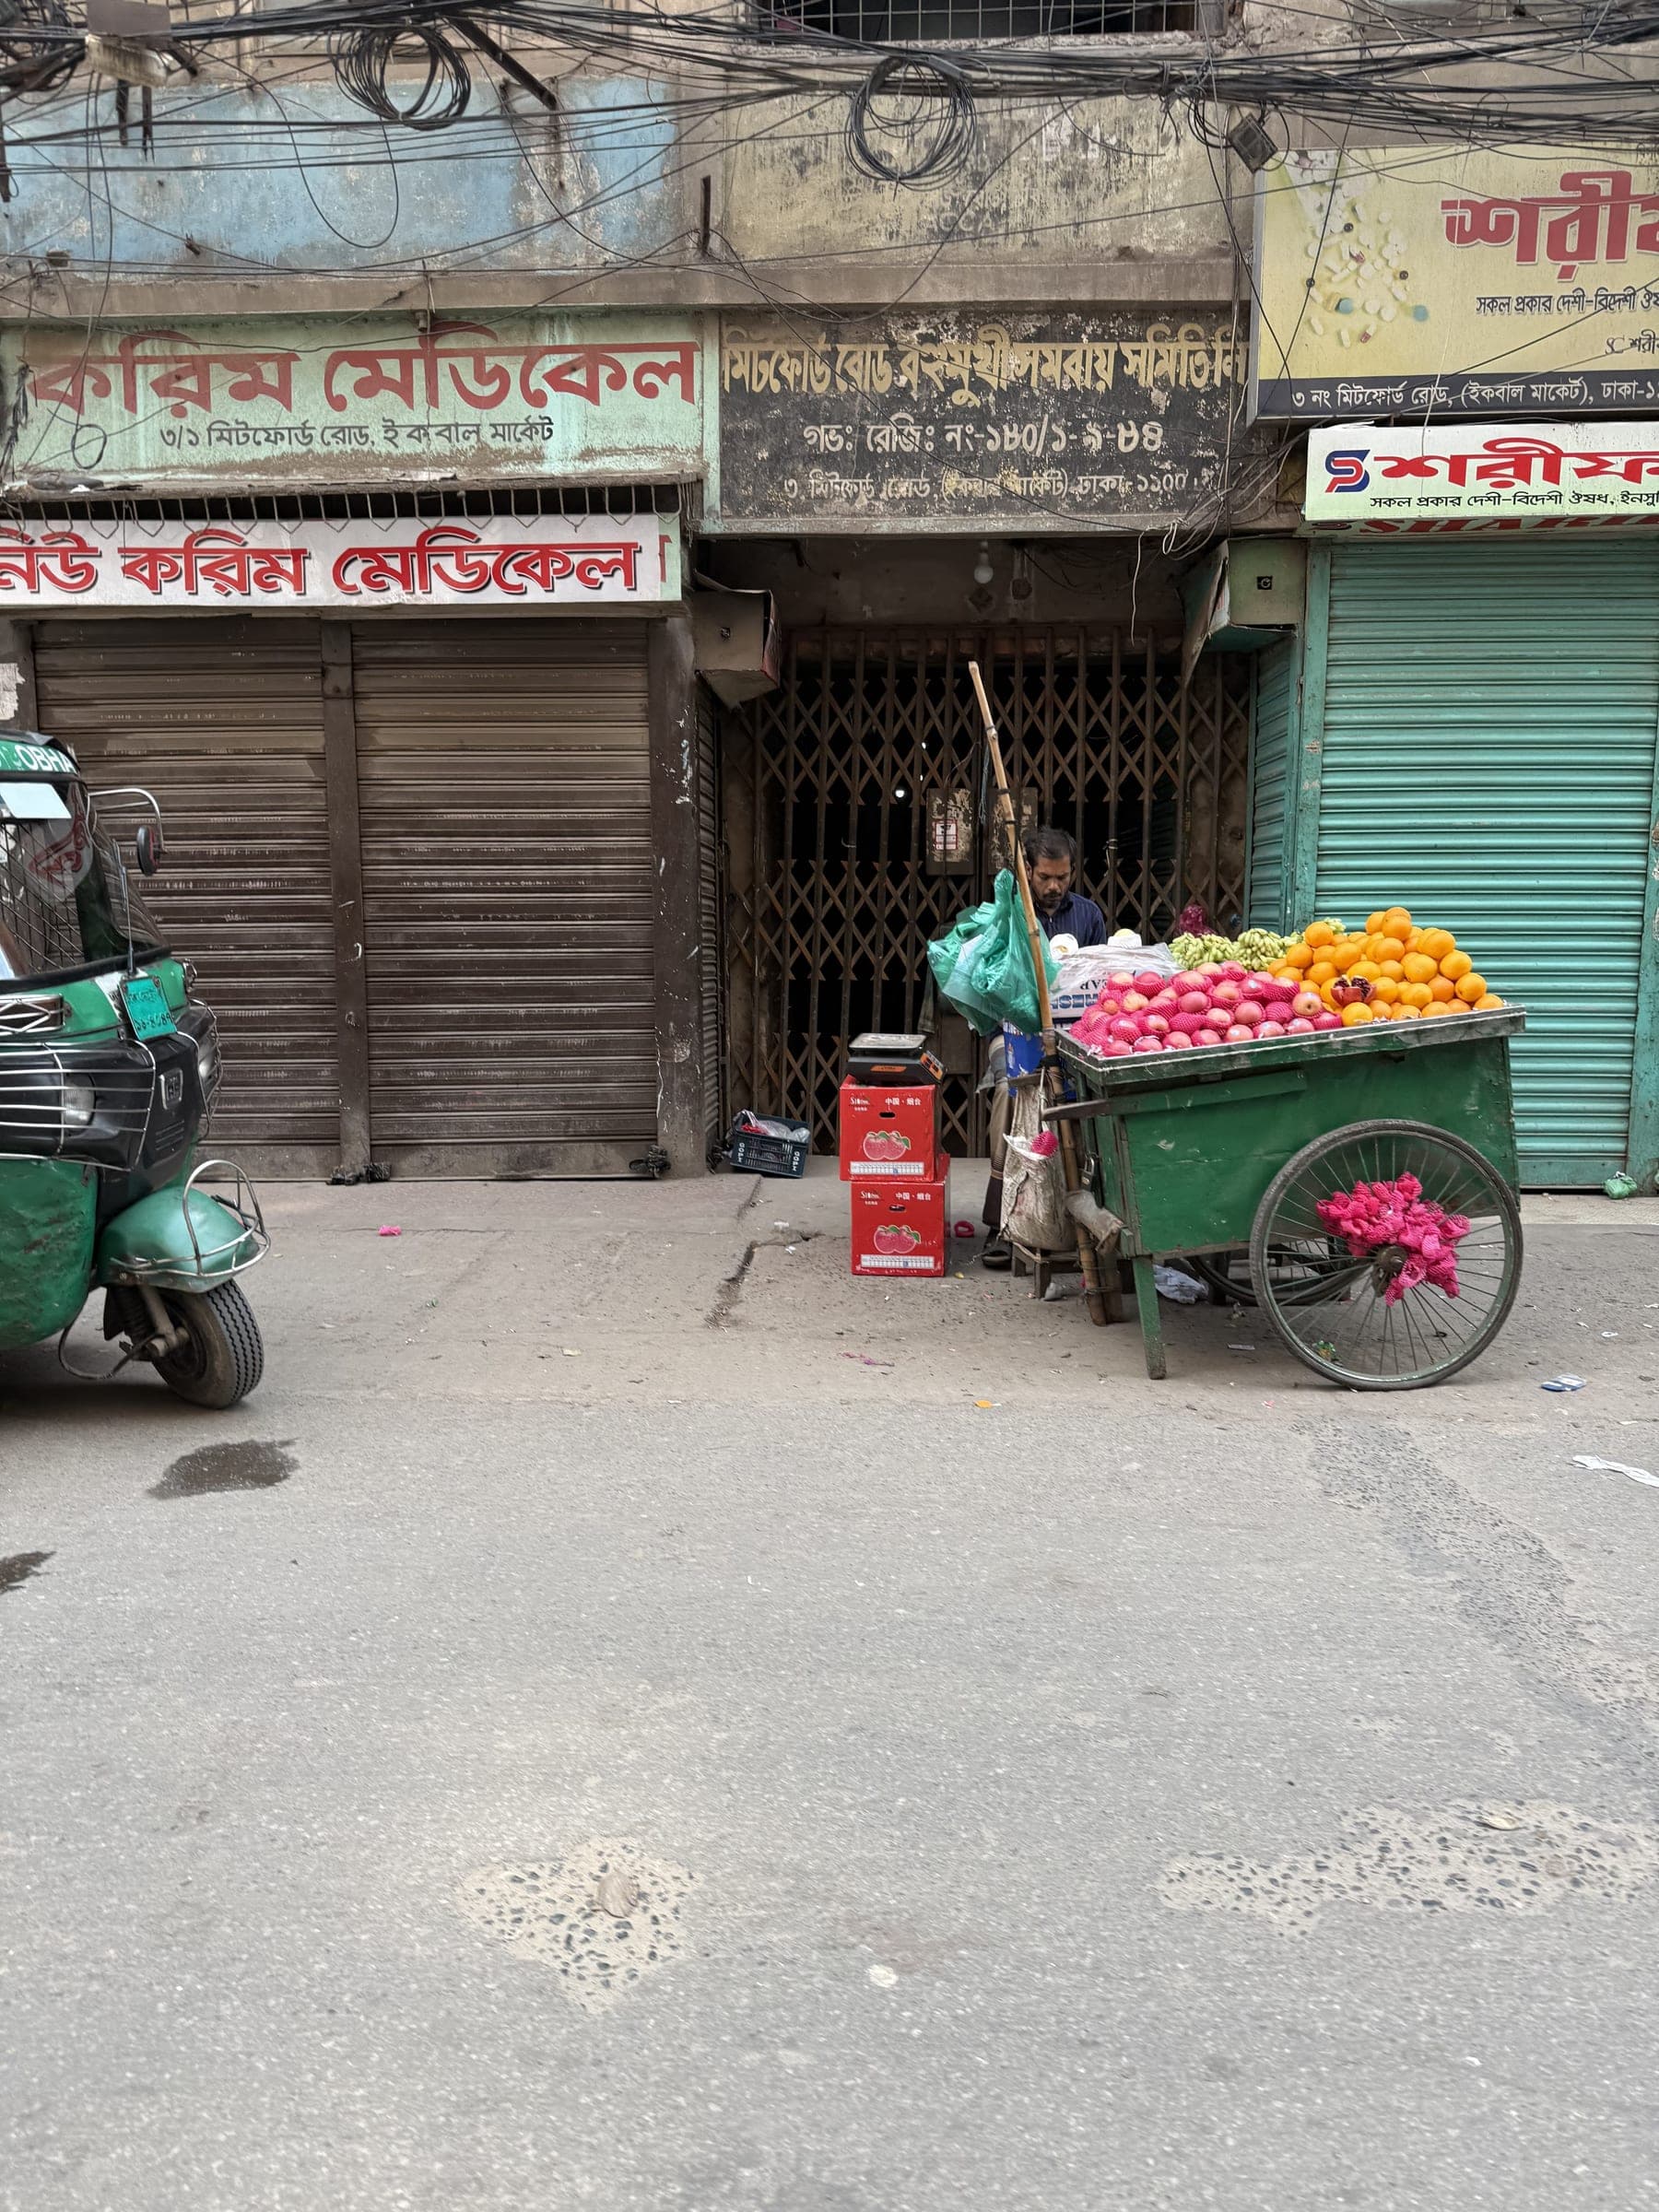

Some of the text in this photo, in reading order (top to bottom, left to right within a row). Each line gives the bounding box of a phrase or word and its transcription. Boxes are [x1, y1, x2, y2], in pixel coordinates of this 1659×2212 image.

[1477, 295, 1512, 314] সকল
[1514, 294, 1552, 314] প্রকার
[26, 321, 700, 418] করিম মেডিকেল
[1292, 393, 1305, 407] ৩
[1311, 390, 1332, 408] নং
[1336, 381, 1408, 407] মিটফোর্ড
[1601, 379, 1659, 402] ঢাকা-১
[160, 427, 201, 450] ৩/১
[207, 418, 316, 449] মিটফোর্ড
[489, 415, 554, 443] মার্কেট
[1370, 496, 1412, 509] সকল
[1417, 495, 1462, 509] প্রকার
[1467, 490, 1563, 507] দেশী-বিদেশী
[118, 528, 311, 596] করিম
[332, 524, 641, 594] মেডিকেল
